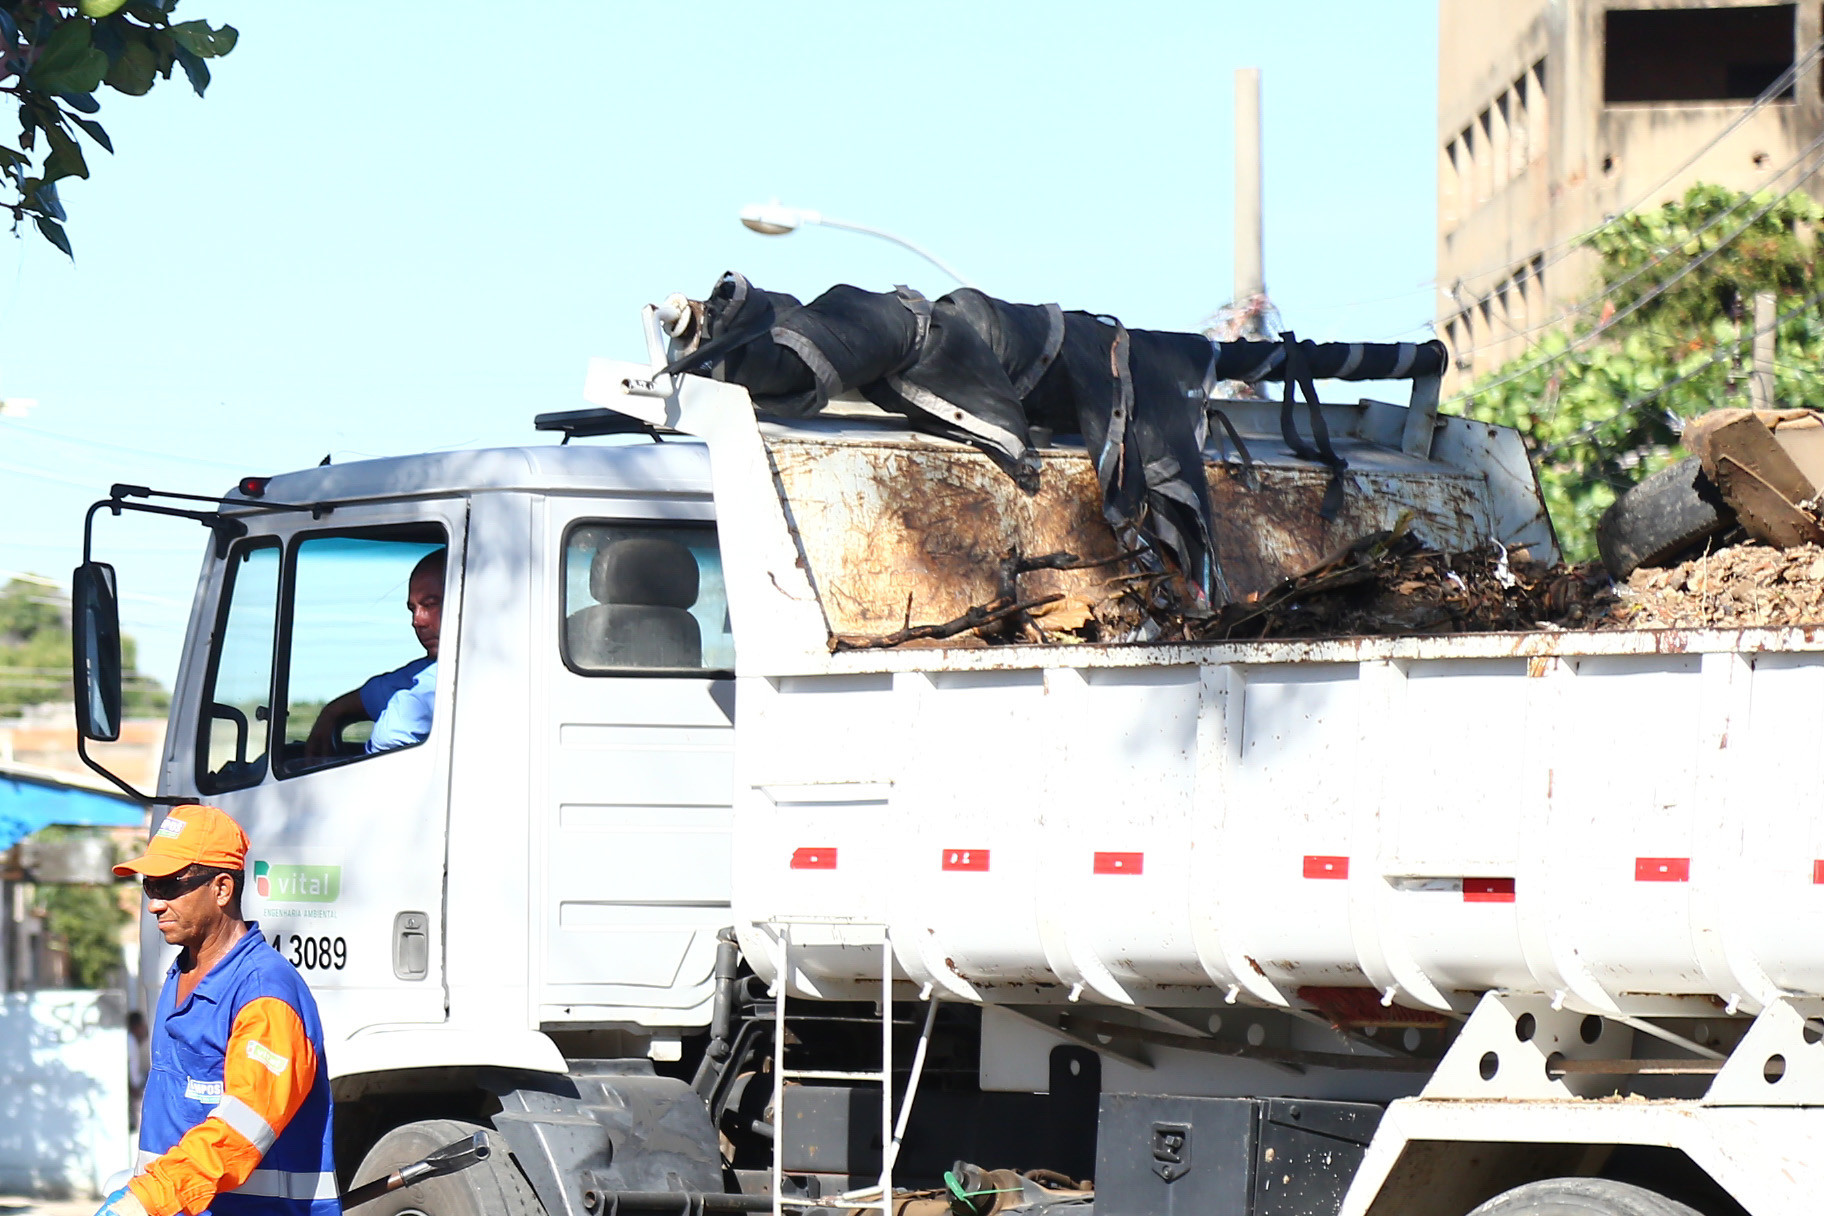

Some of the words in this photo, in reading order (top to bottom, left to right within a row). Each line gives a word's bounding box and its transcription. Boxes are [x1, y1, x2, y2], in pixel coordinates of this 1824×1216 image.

[278, 872, 329, 896] vital
[263, 908, 302, 918] ENGENHARIA
[303, 909, 338, 919] AMBIENTAL
